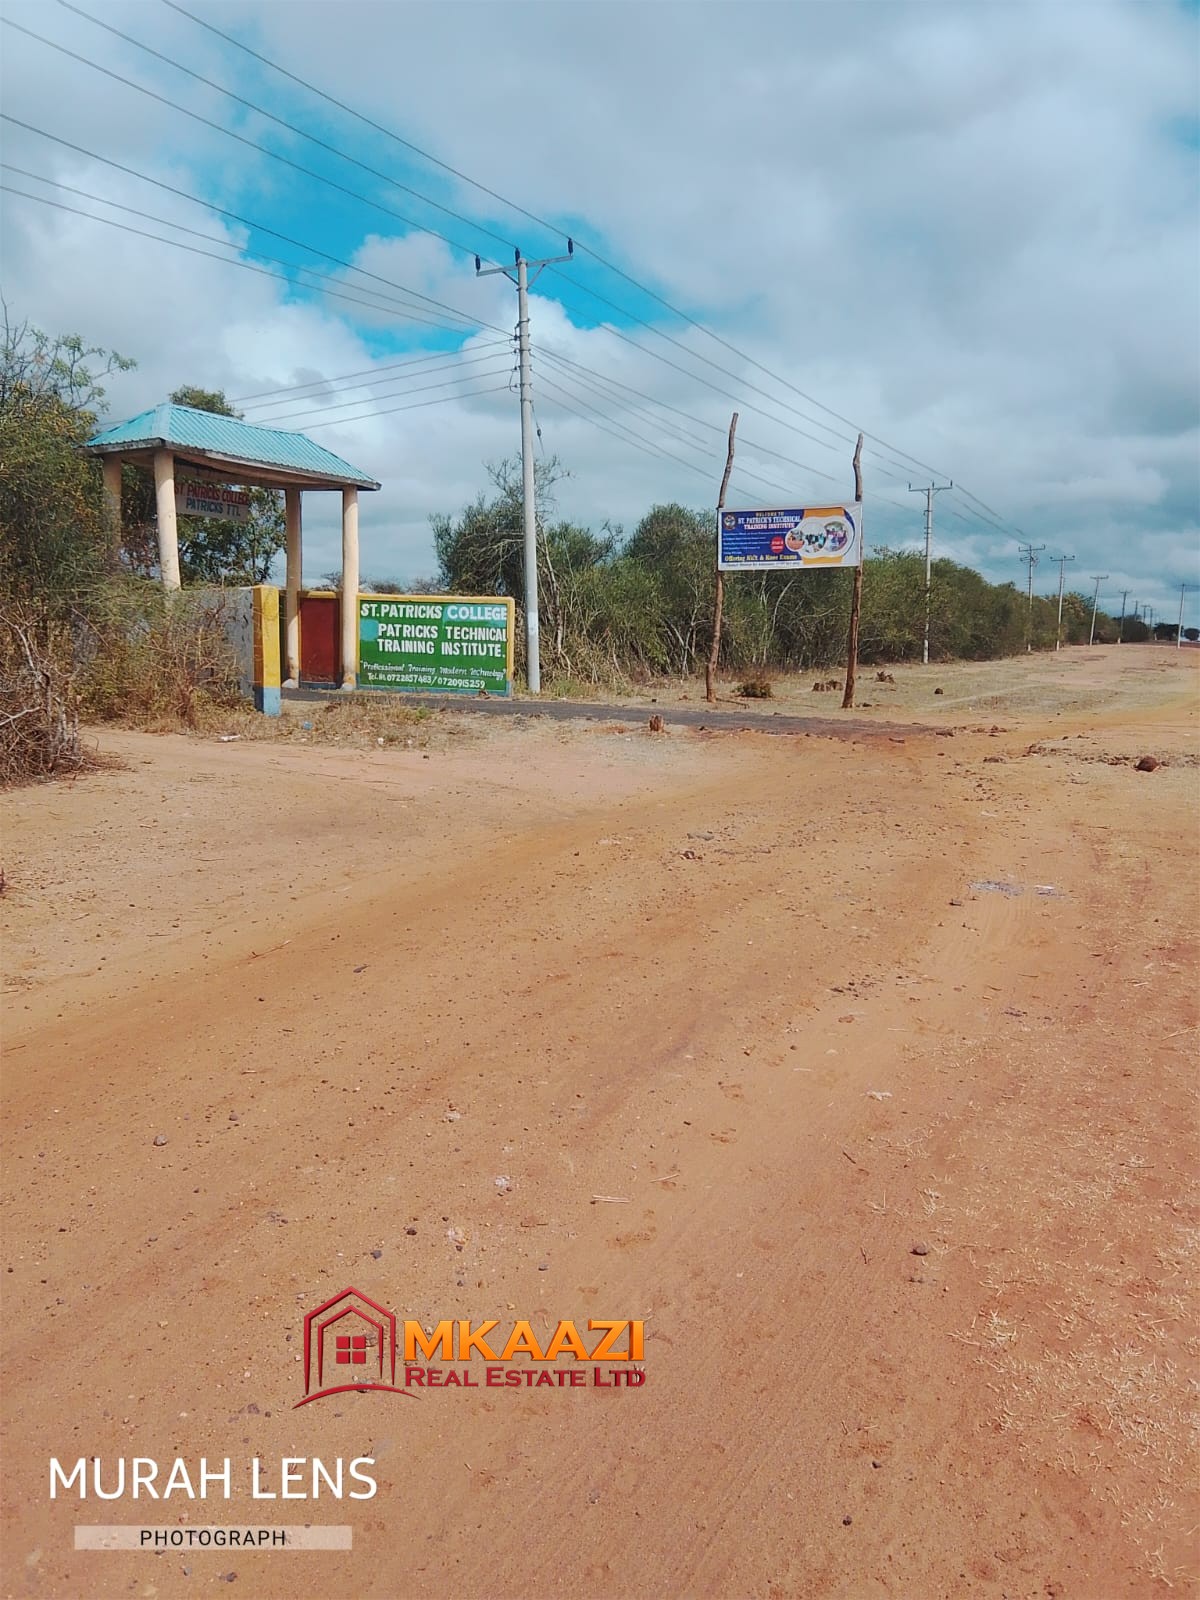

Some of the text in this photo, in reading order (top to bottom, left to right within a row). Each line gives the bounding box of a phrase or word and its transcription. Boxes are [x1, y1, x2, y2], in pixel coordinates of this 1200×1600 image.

[447, 606, 507, 620] COLLEGE
[378, 624, 508, 642] PATRICKS TECHNICAL
[377, 638, 506, 658] TRAINING INSTITUTE.
